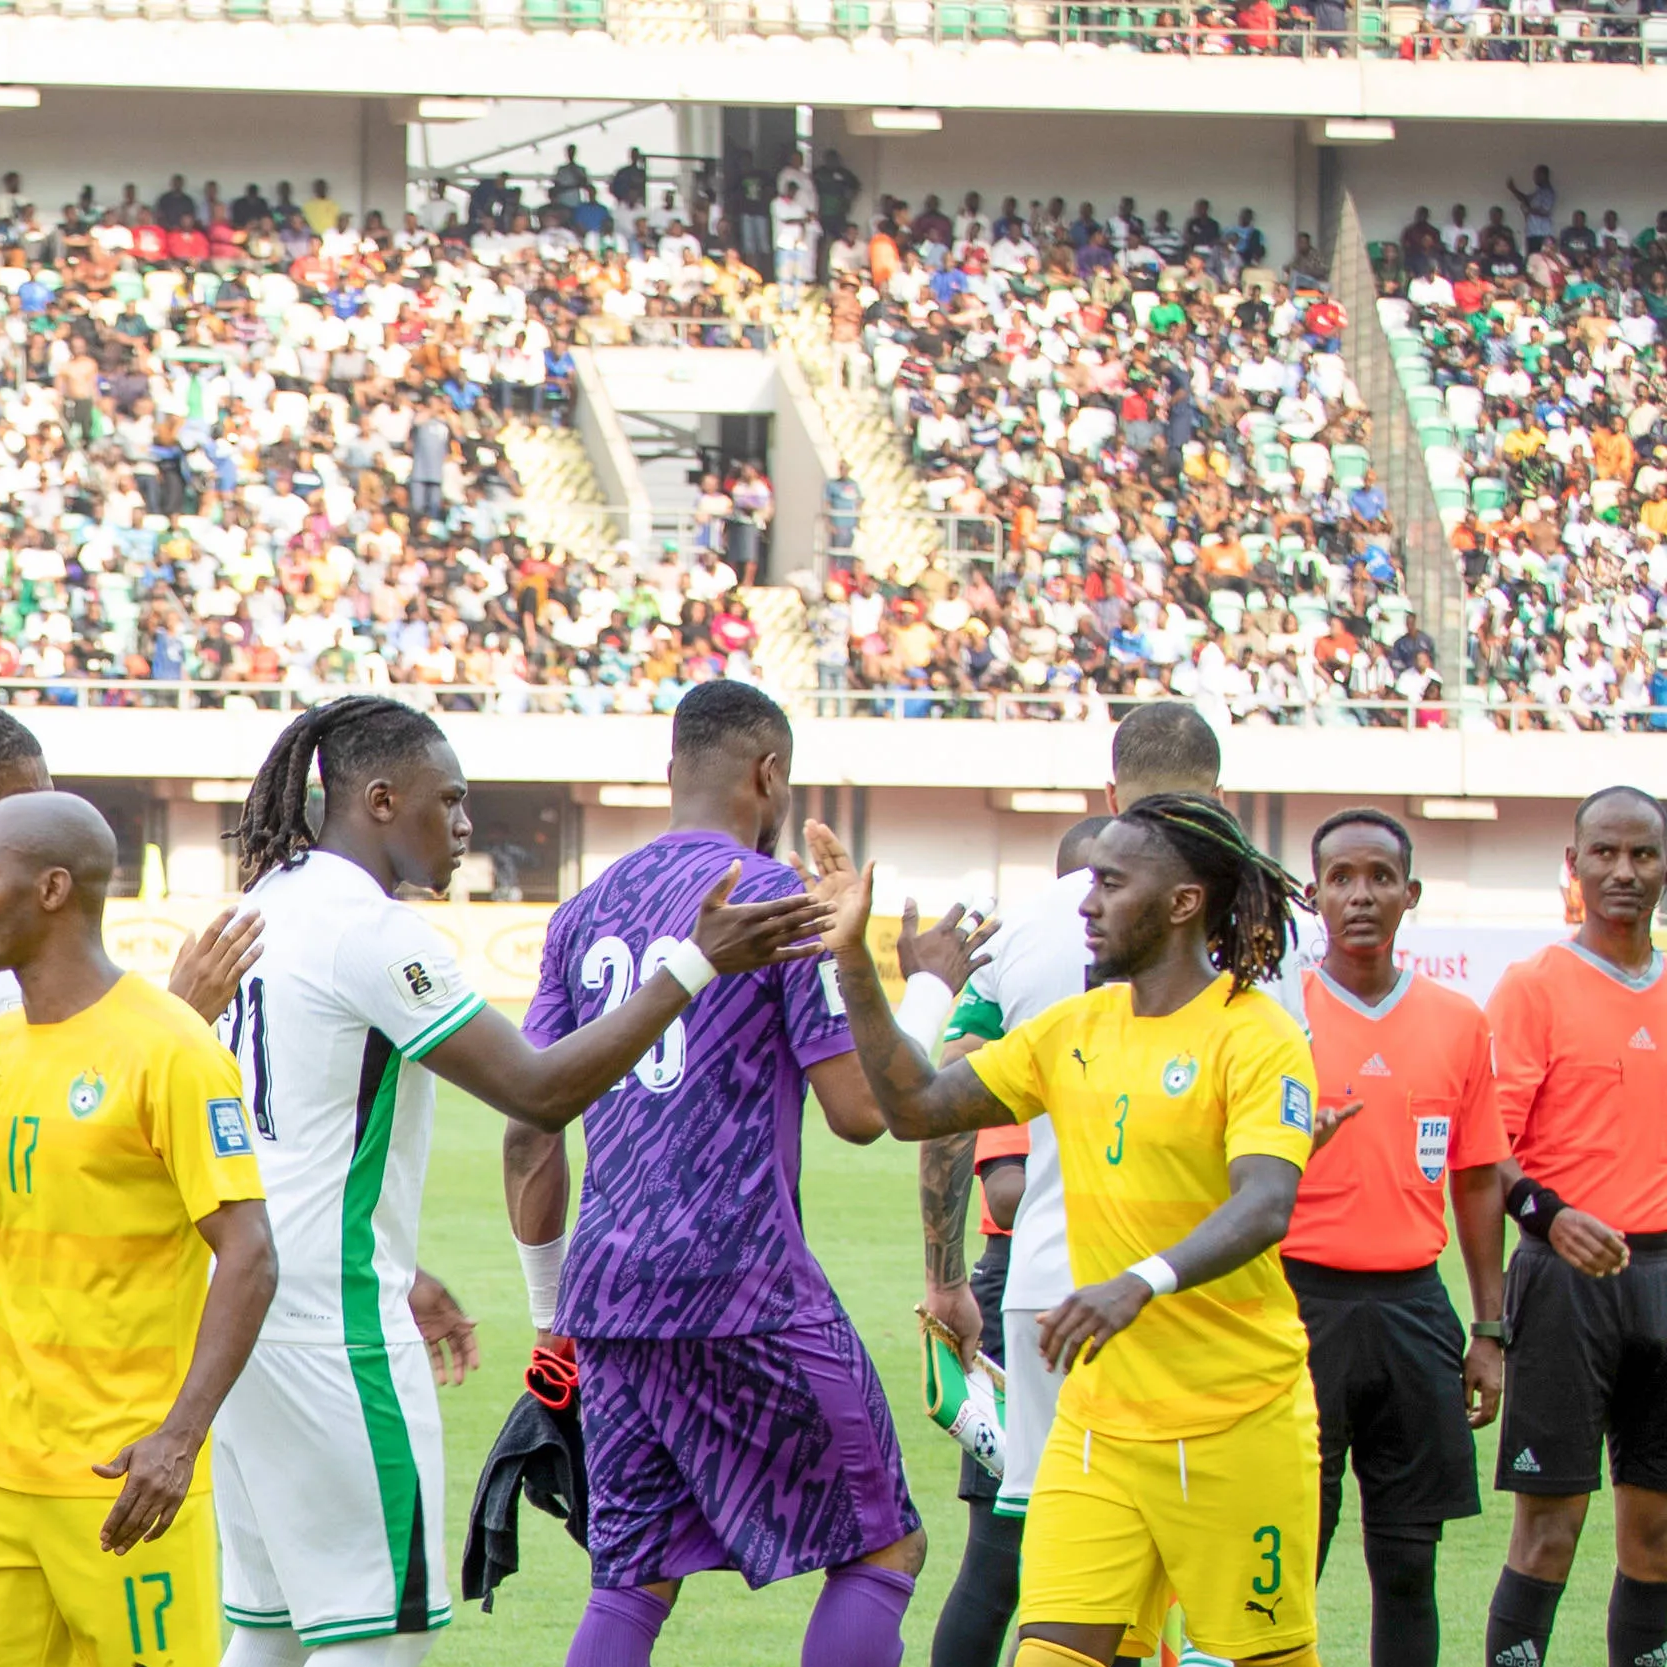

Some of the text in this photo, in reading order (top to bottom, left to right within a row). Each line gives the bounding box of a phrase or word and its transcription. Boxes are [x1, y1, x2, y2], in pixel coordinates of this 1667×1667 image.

[7, 1115, 41, 1194] 17
[1106, 1093, 1130, 1167] 3
[1420, 1122, 1448, 1137] FIFA
[1251, 1525, 1283, 1596] 3
[124, 1571, 175, 1655] 17
